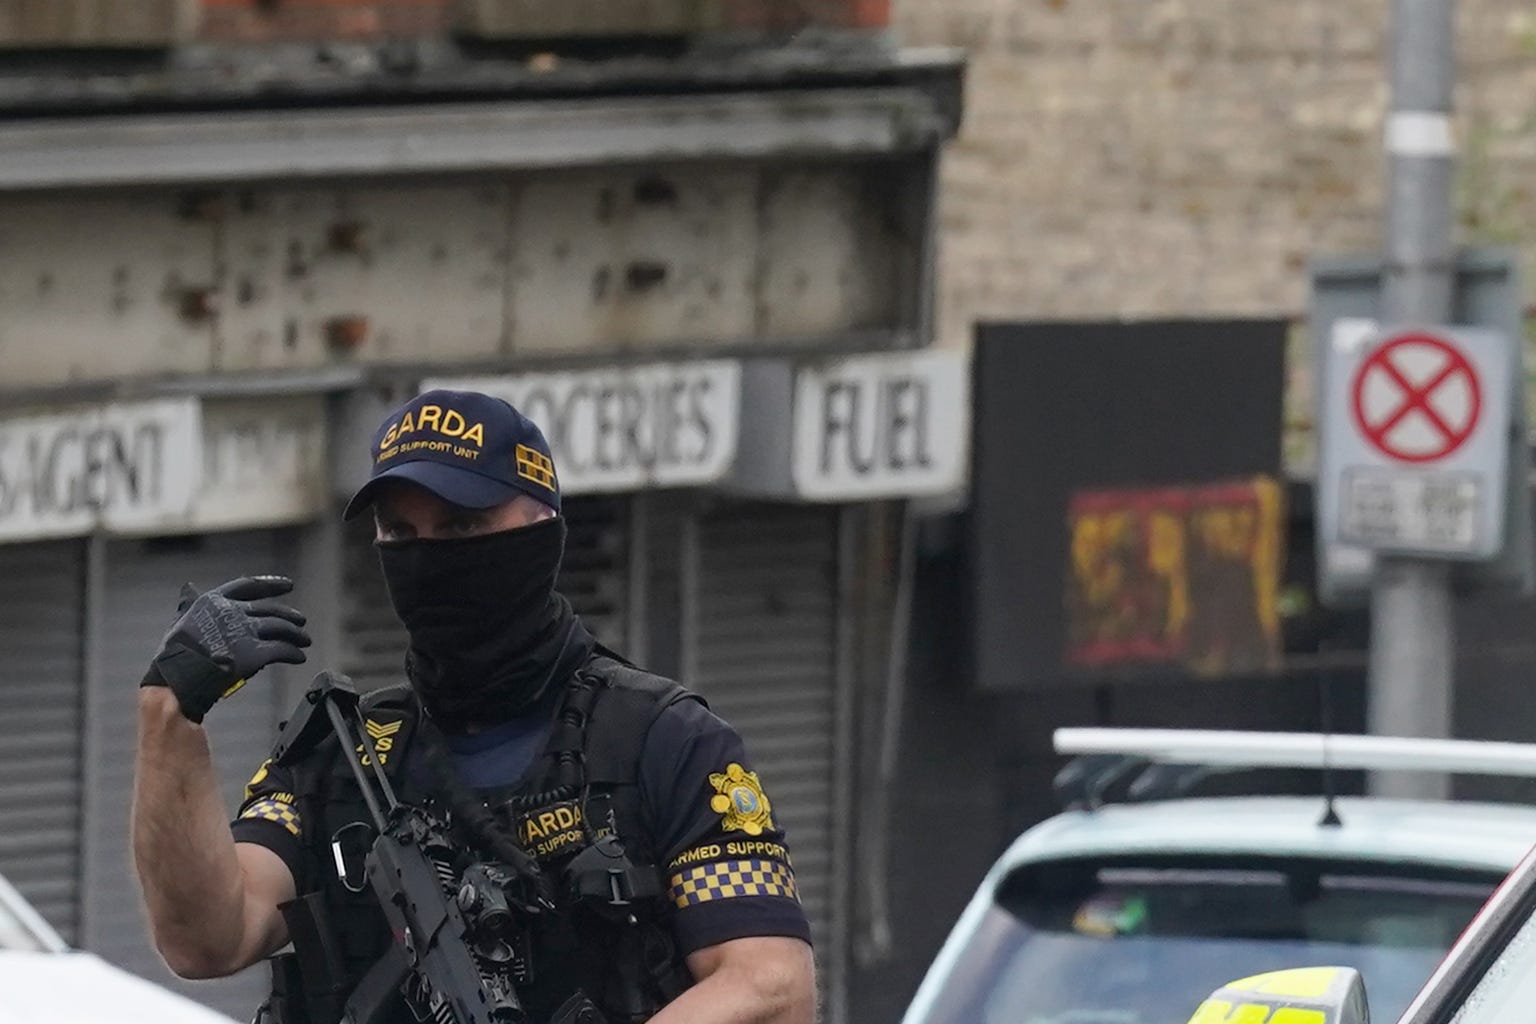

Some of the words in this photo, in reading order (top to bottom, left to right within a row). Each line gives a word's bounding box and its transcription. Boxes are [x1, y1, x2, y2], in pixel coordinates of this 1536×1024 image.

[379, 405, 484, 448] GARDA
[820, 378, 934, 476] FUEL
[400, 440, 452, 453] SUPPORT
[453, 445, 480, 460] UNIT
[669, 844, 720, 868] ARMED
[727, 842, 785, 857] SUPPORT
